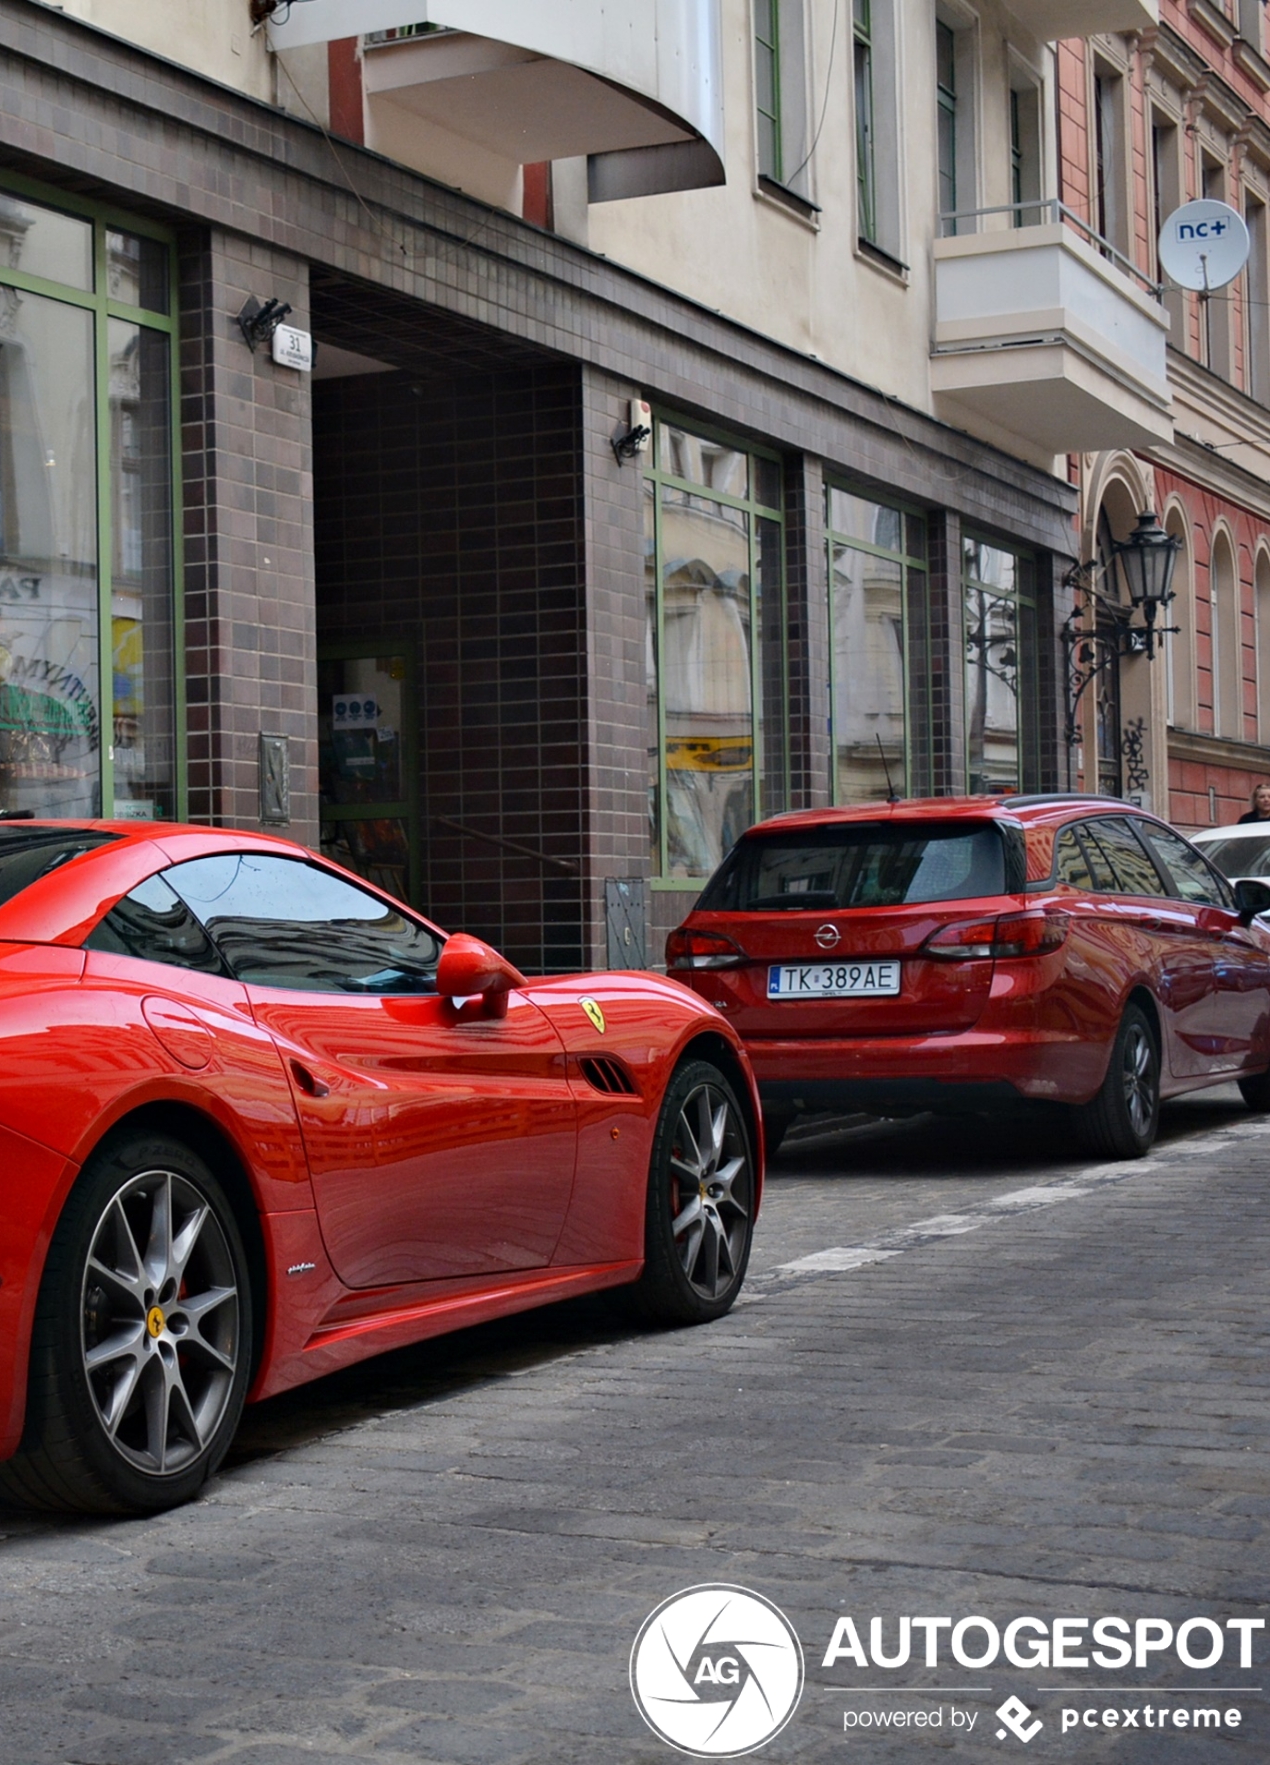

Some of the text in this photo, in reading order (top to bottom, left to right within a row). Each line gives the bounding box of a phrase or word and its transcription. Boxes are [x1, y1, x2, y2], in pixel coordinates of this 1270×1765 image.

[1179, 220, 1226, 240] nc+
[289, 334, 301, 352] 31
[784, 968, 813, 991] TK
[821, 965, 893, 990] 389AE
